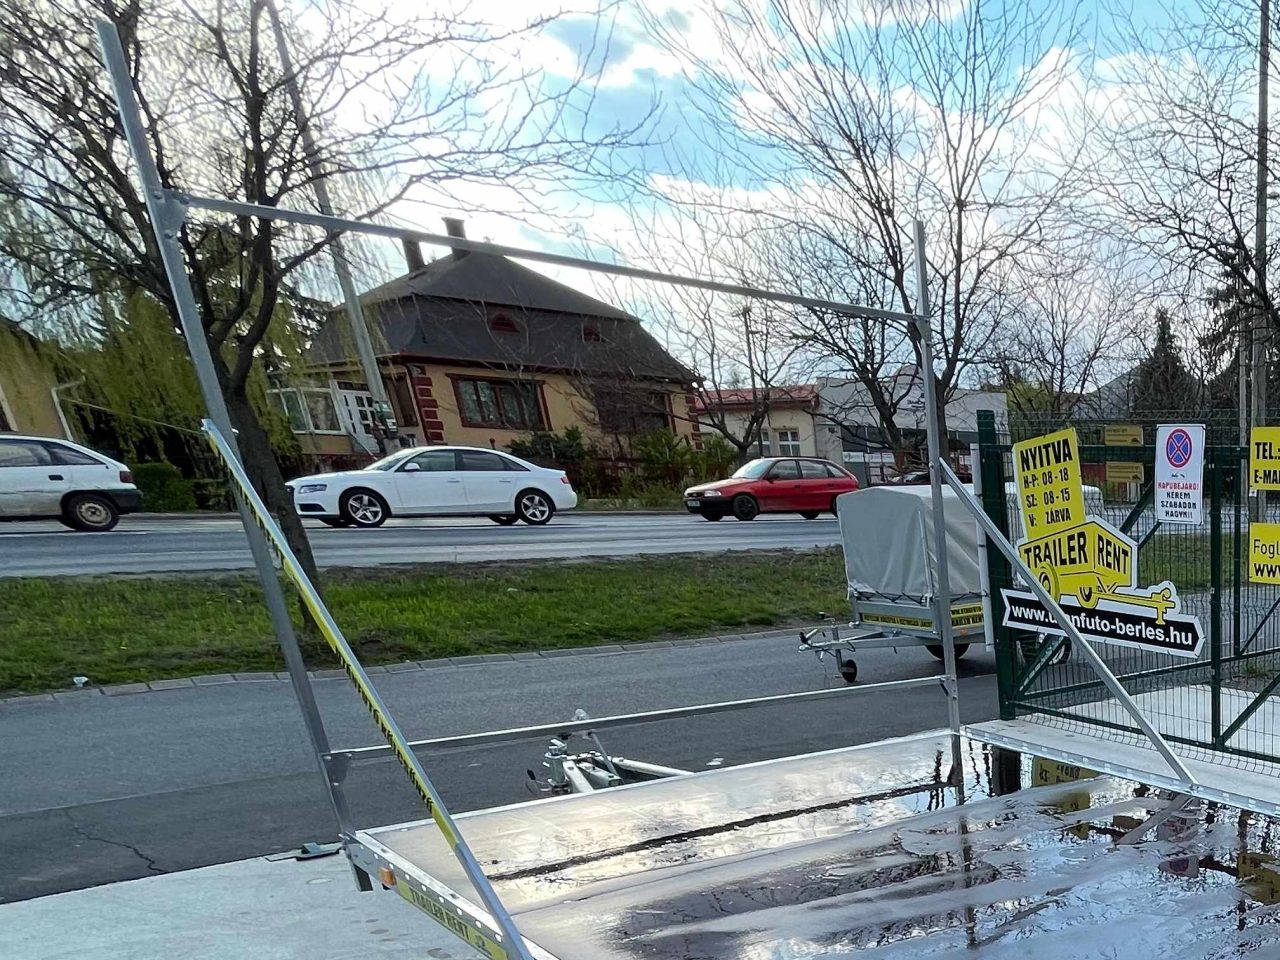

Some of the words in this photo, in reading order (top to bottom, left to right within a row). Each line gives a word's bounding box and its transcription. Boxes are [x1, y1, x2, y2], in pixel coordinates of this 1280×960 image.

[1020, 438, 1073, 472] NYITVA
[1255, 441, 1280, 460] TEL.:
[1160, 500, 1197, 509] SZABADON
[1023, 531, 1088, 569] TRAILER
[1097, 533, 1129, 575] RENT
[1011, 605, 1193, 646] www.unfuto-berles.hu
